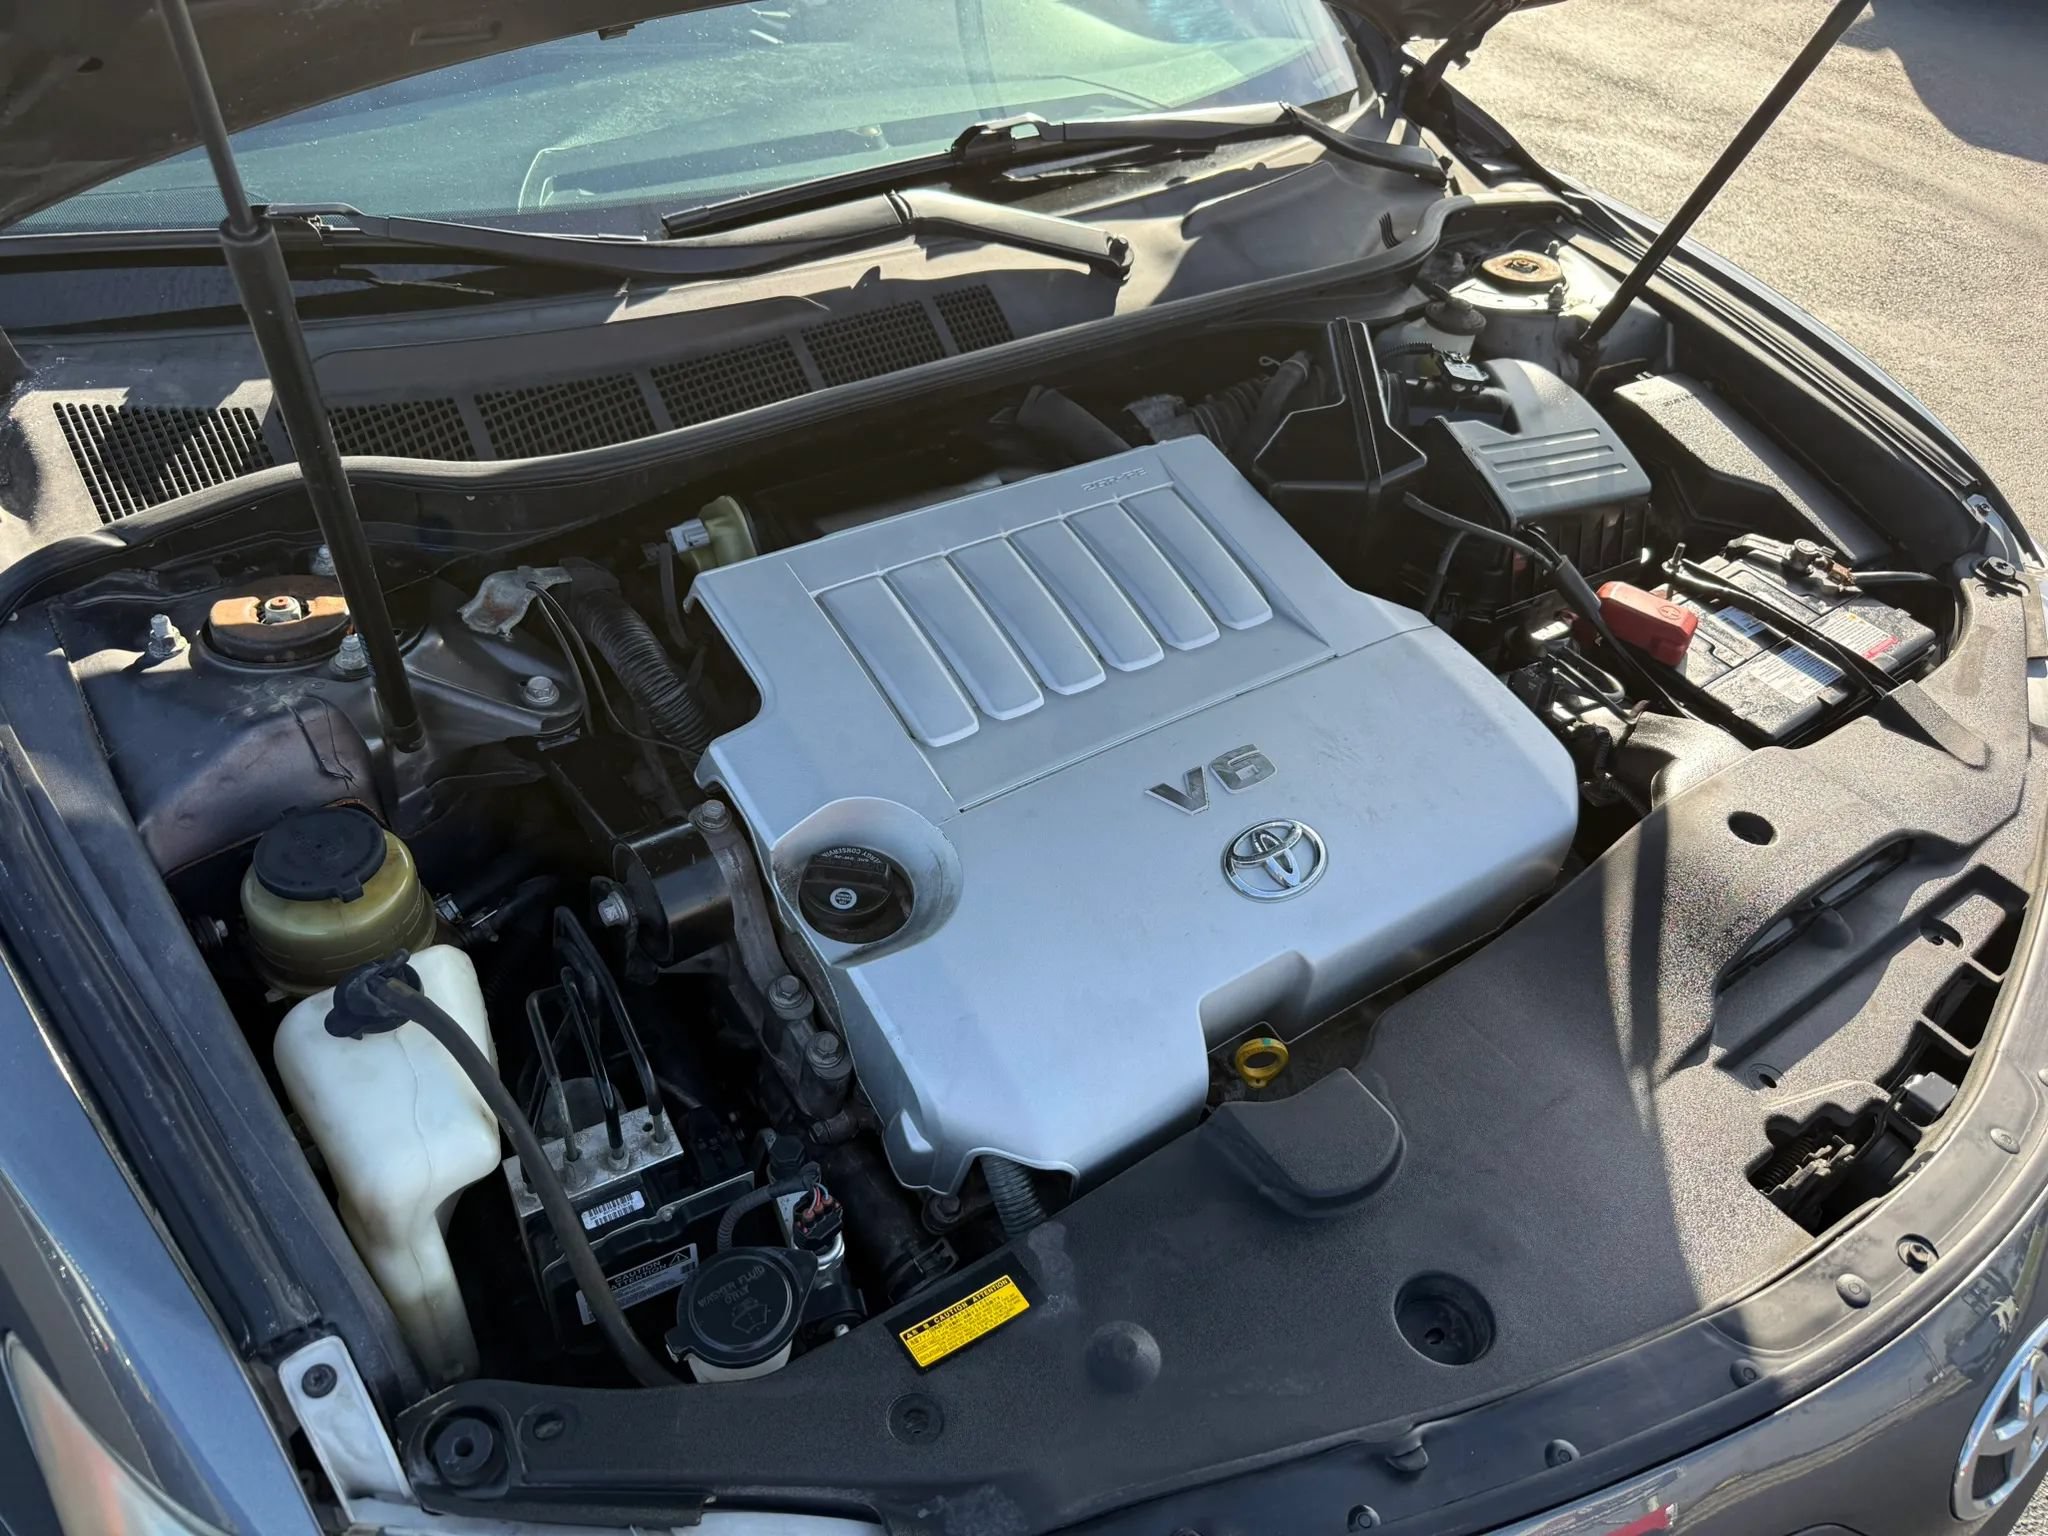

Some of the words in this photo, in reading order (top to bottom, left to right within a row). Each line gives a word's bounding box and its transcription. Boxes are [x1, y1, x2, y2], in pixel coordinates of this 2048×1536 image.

[1144, 743, 1278, 816] V6
[611, 1263, 668, 1291] ATTENTION
[614, 1260, 662, 1283] CAUTION
[697, 1281, 737, 1308] WASHER
[738, 1264, 766, 1285] FLUID
[724, 1284, 750, 1305] ONLY
[933, 1301, 968, 1323] CAUTION
[972, 1279, 1008, 1303] ATTENTION
